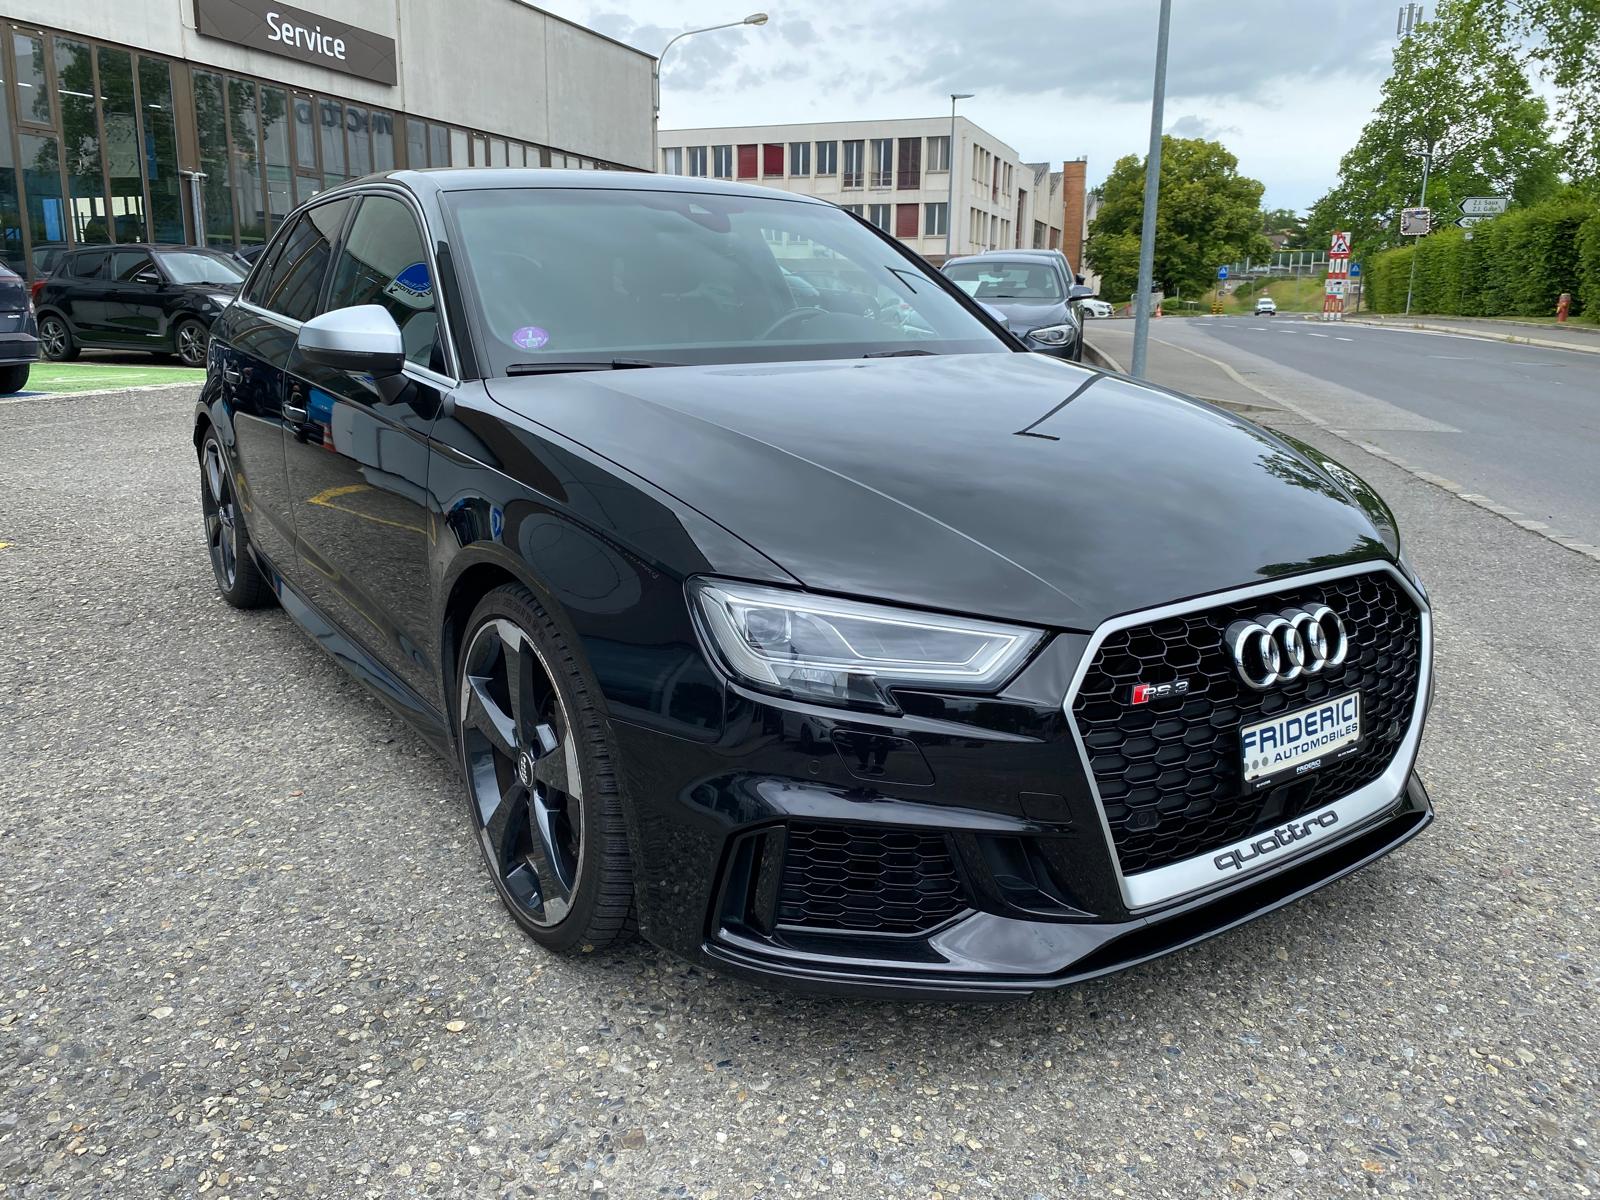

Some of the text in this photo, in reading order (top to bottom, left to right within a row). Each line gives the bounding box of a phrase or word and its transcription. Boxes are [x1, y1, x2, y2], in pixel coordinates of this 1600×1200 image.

[266, 12, 346, 60] Service
[1242, 695, 1358, 758] FRIDERICI
[1274, 722, 1358, 763] AUTOMOBILES
[1213, 810, 1339, 870] quattro
